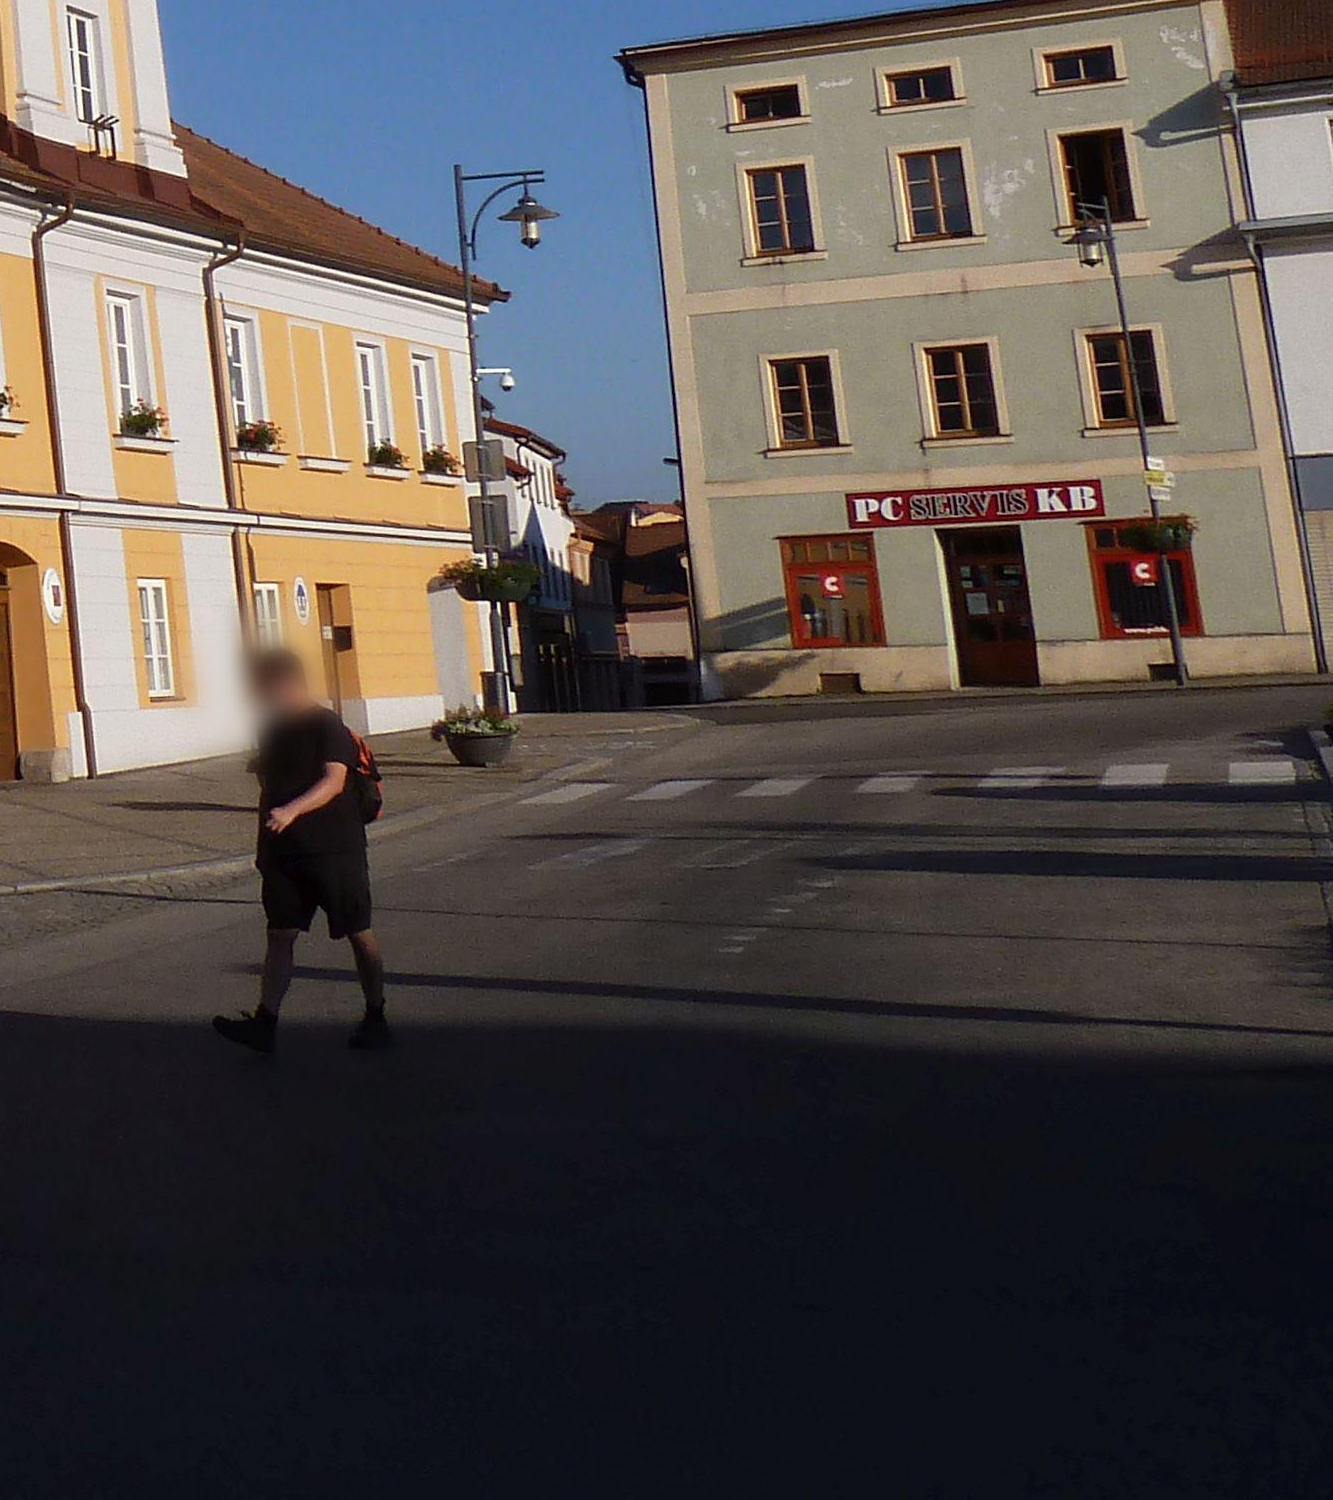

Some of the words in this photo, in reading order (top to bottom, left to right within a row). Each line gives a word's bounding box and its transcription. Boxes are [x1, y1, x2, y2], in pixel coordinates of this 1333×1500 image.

[852, 497, 903, 523] PC
[909, 488, 1030, 520] SERVIS
[1034, 485, 1098, 514] KB
